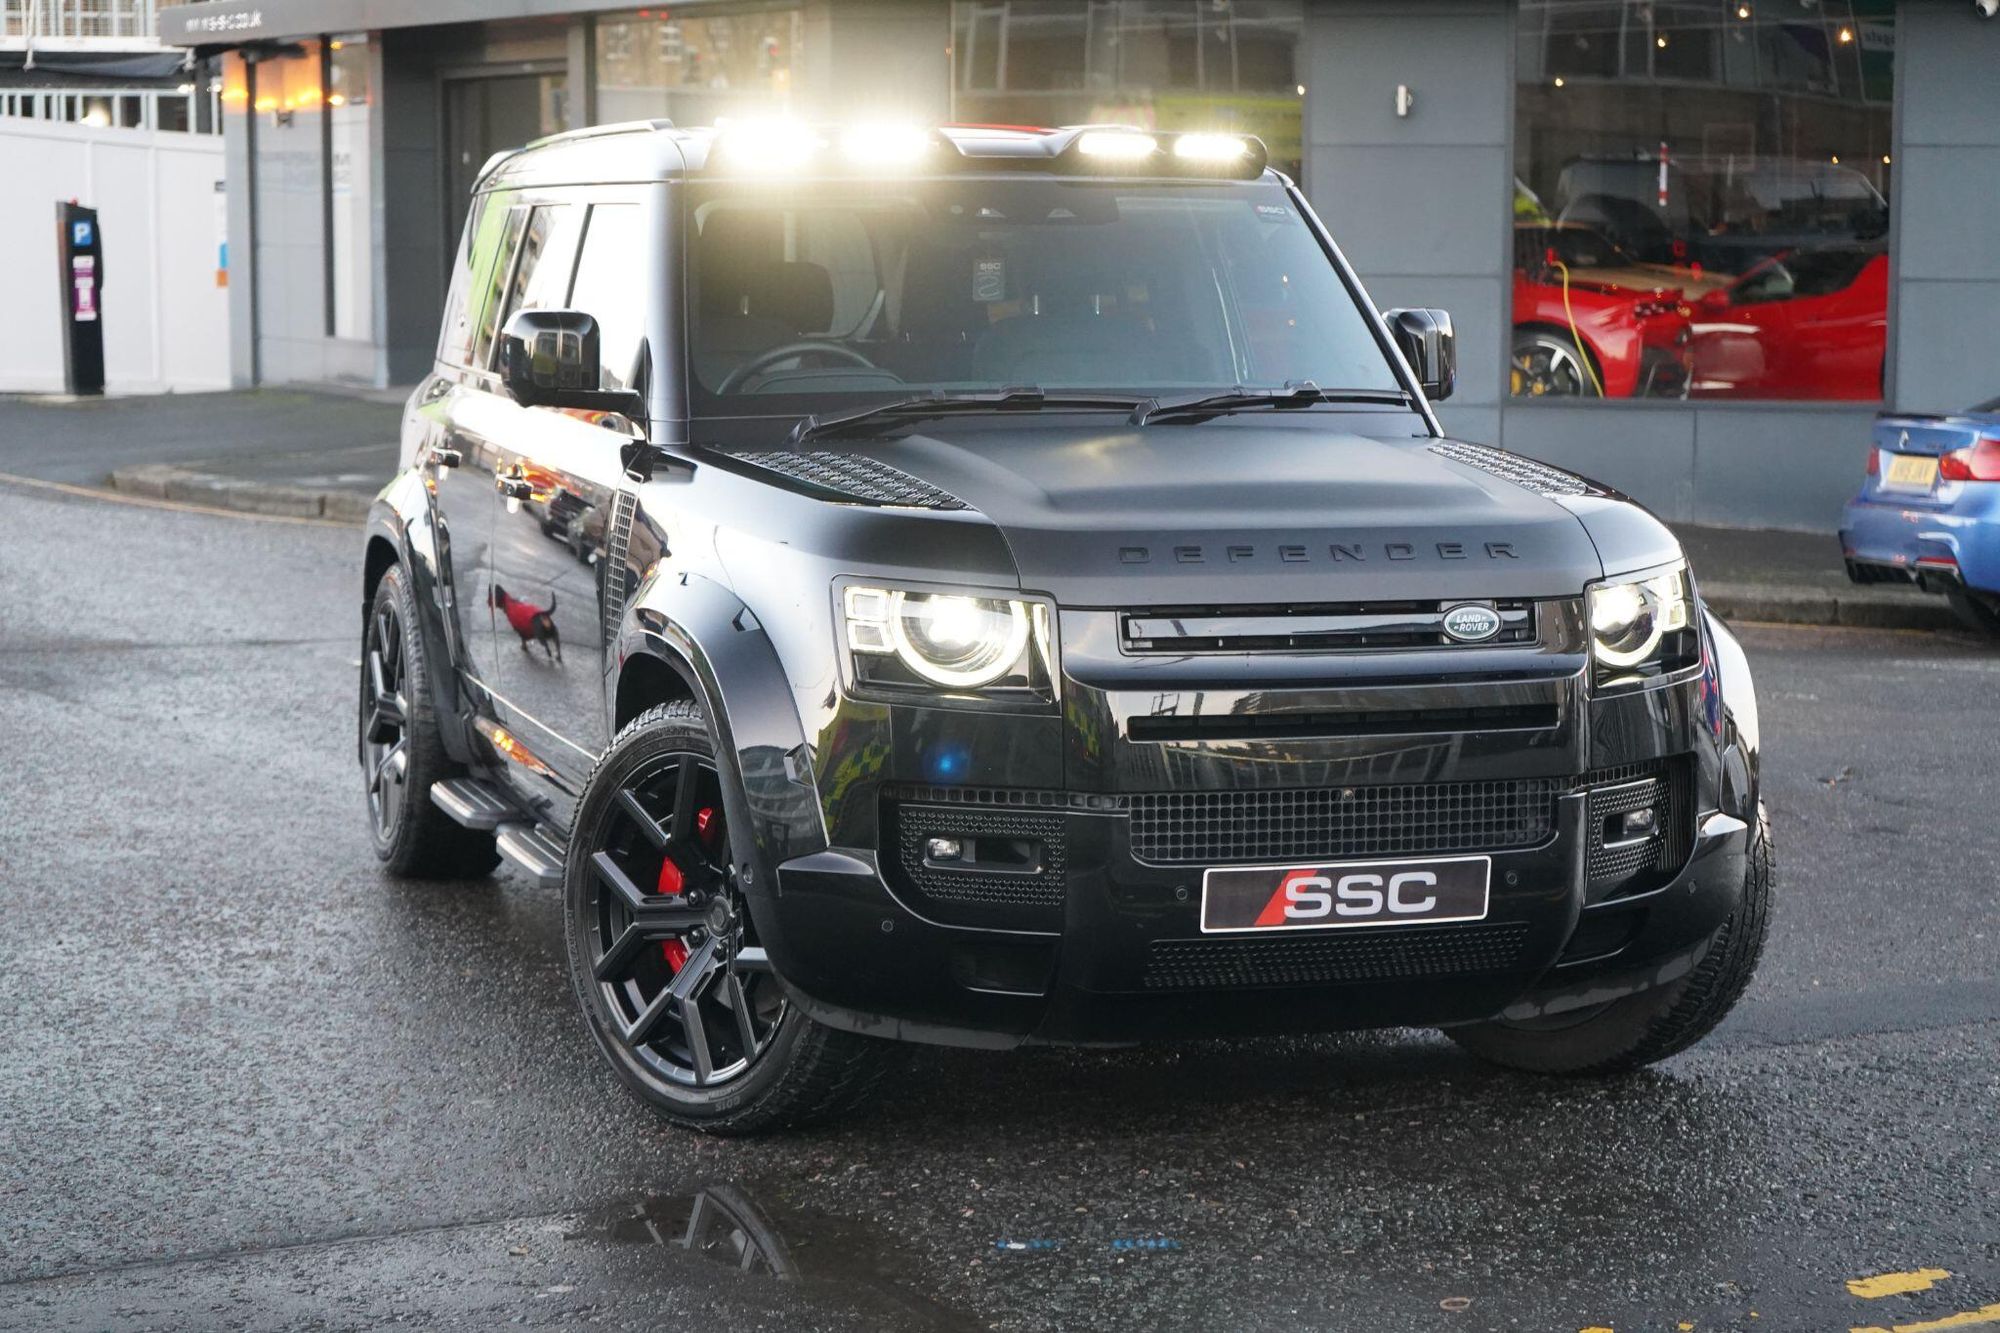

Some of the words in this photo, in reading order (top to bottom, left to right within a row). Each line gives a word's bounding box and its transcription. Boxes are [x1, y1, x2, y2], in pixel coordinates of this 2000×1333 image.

[74, 222, 91, 244] P
[1118, 542, 1520, 565] DEFENDER
[1456, 614, 1481, 624] LAND
[1459, 622, 1490, 632] ROVER
[1283, 871, 1437, 918] SSC
